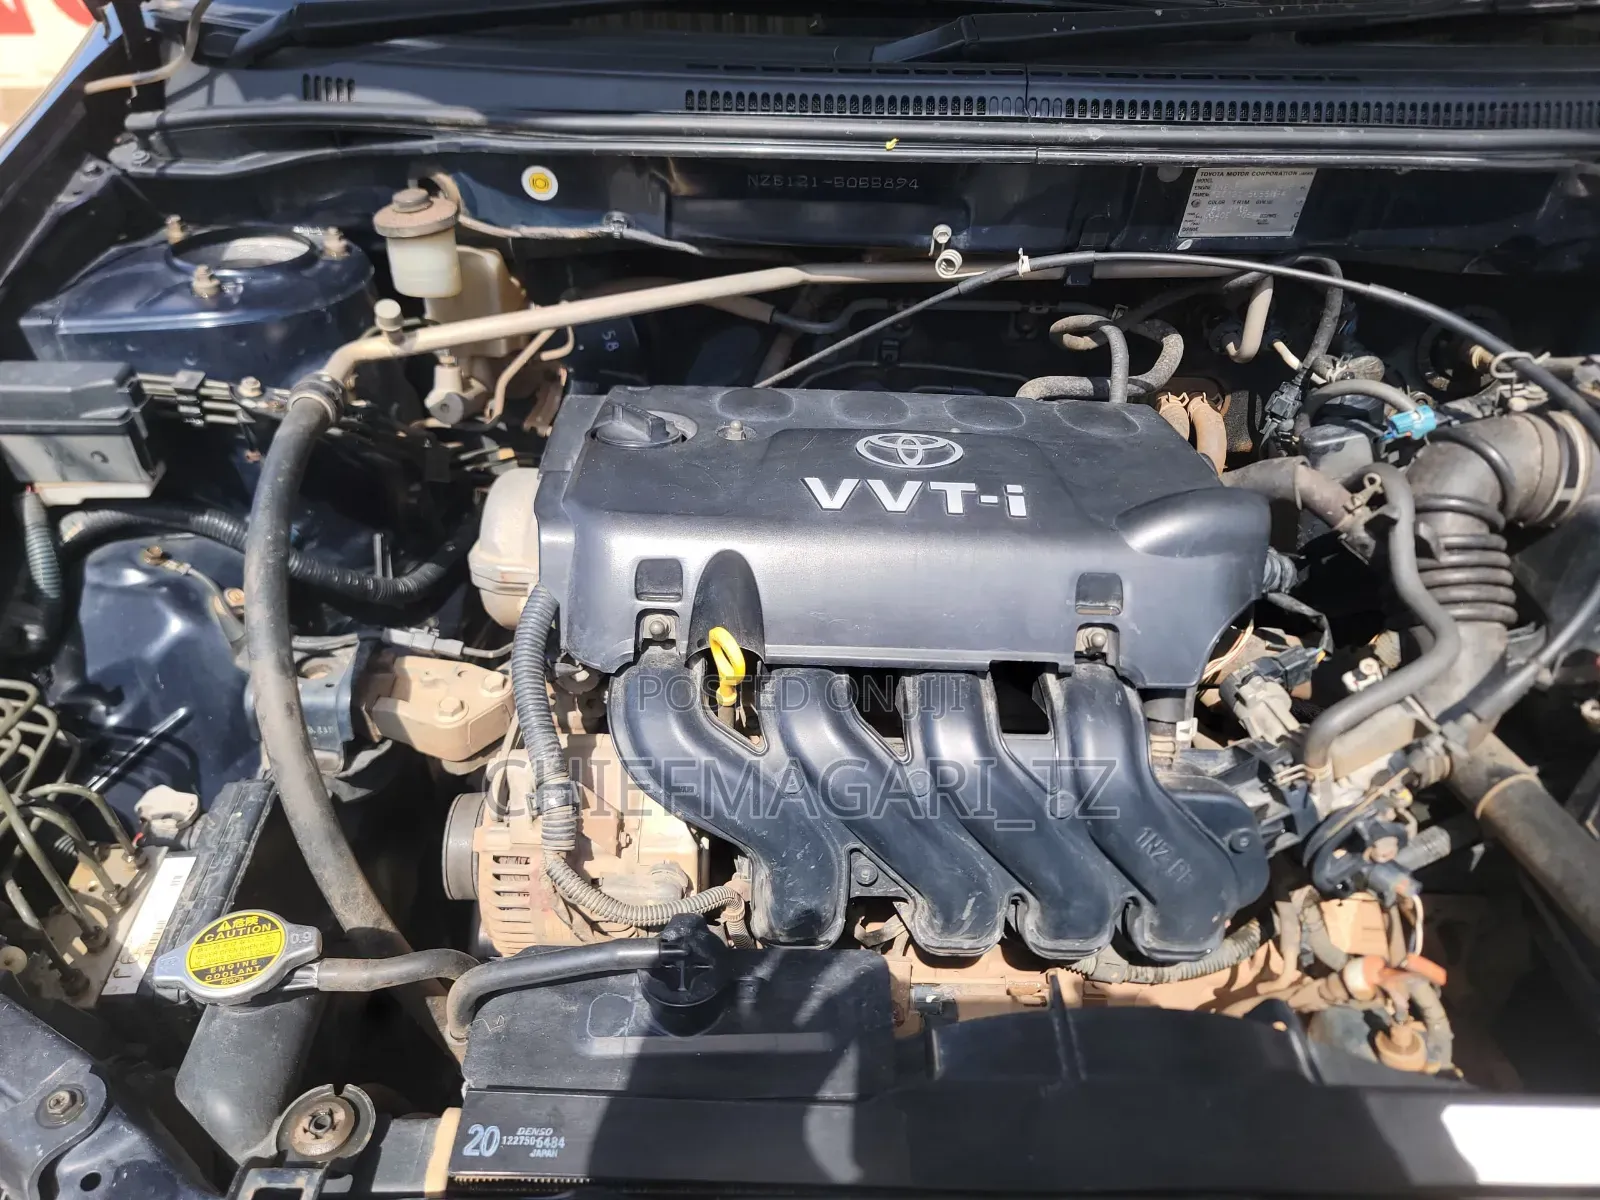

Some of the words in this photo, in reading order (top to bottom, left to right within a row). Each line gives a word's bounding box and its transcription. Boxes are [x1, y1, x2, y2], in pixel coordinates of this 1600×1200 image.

[800, 477, 1027, 518] VVT-i
[204, 923, 271, 942] CAUTION
[290, 931, 312, 944] 0.9
[205, 965, 261, 980] COOLANT
[210, 959, 257, 973] ENGINE
[516, 1127, 554, 1136] DENSO
[462, 1124, 500, 1157] 20
[529, 1148, 559, 1158] JAPAN
